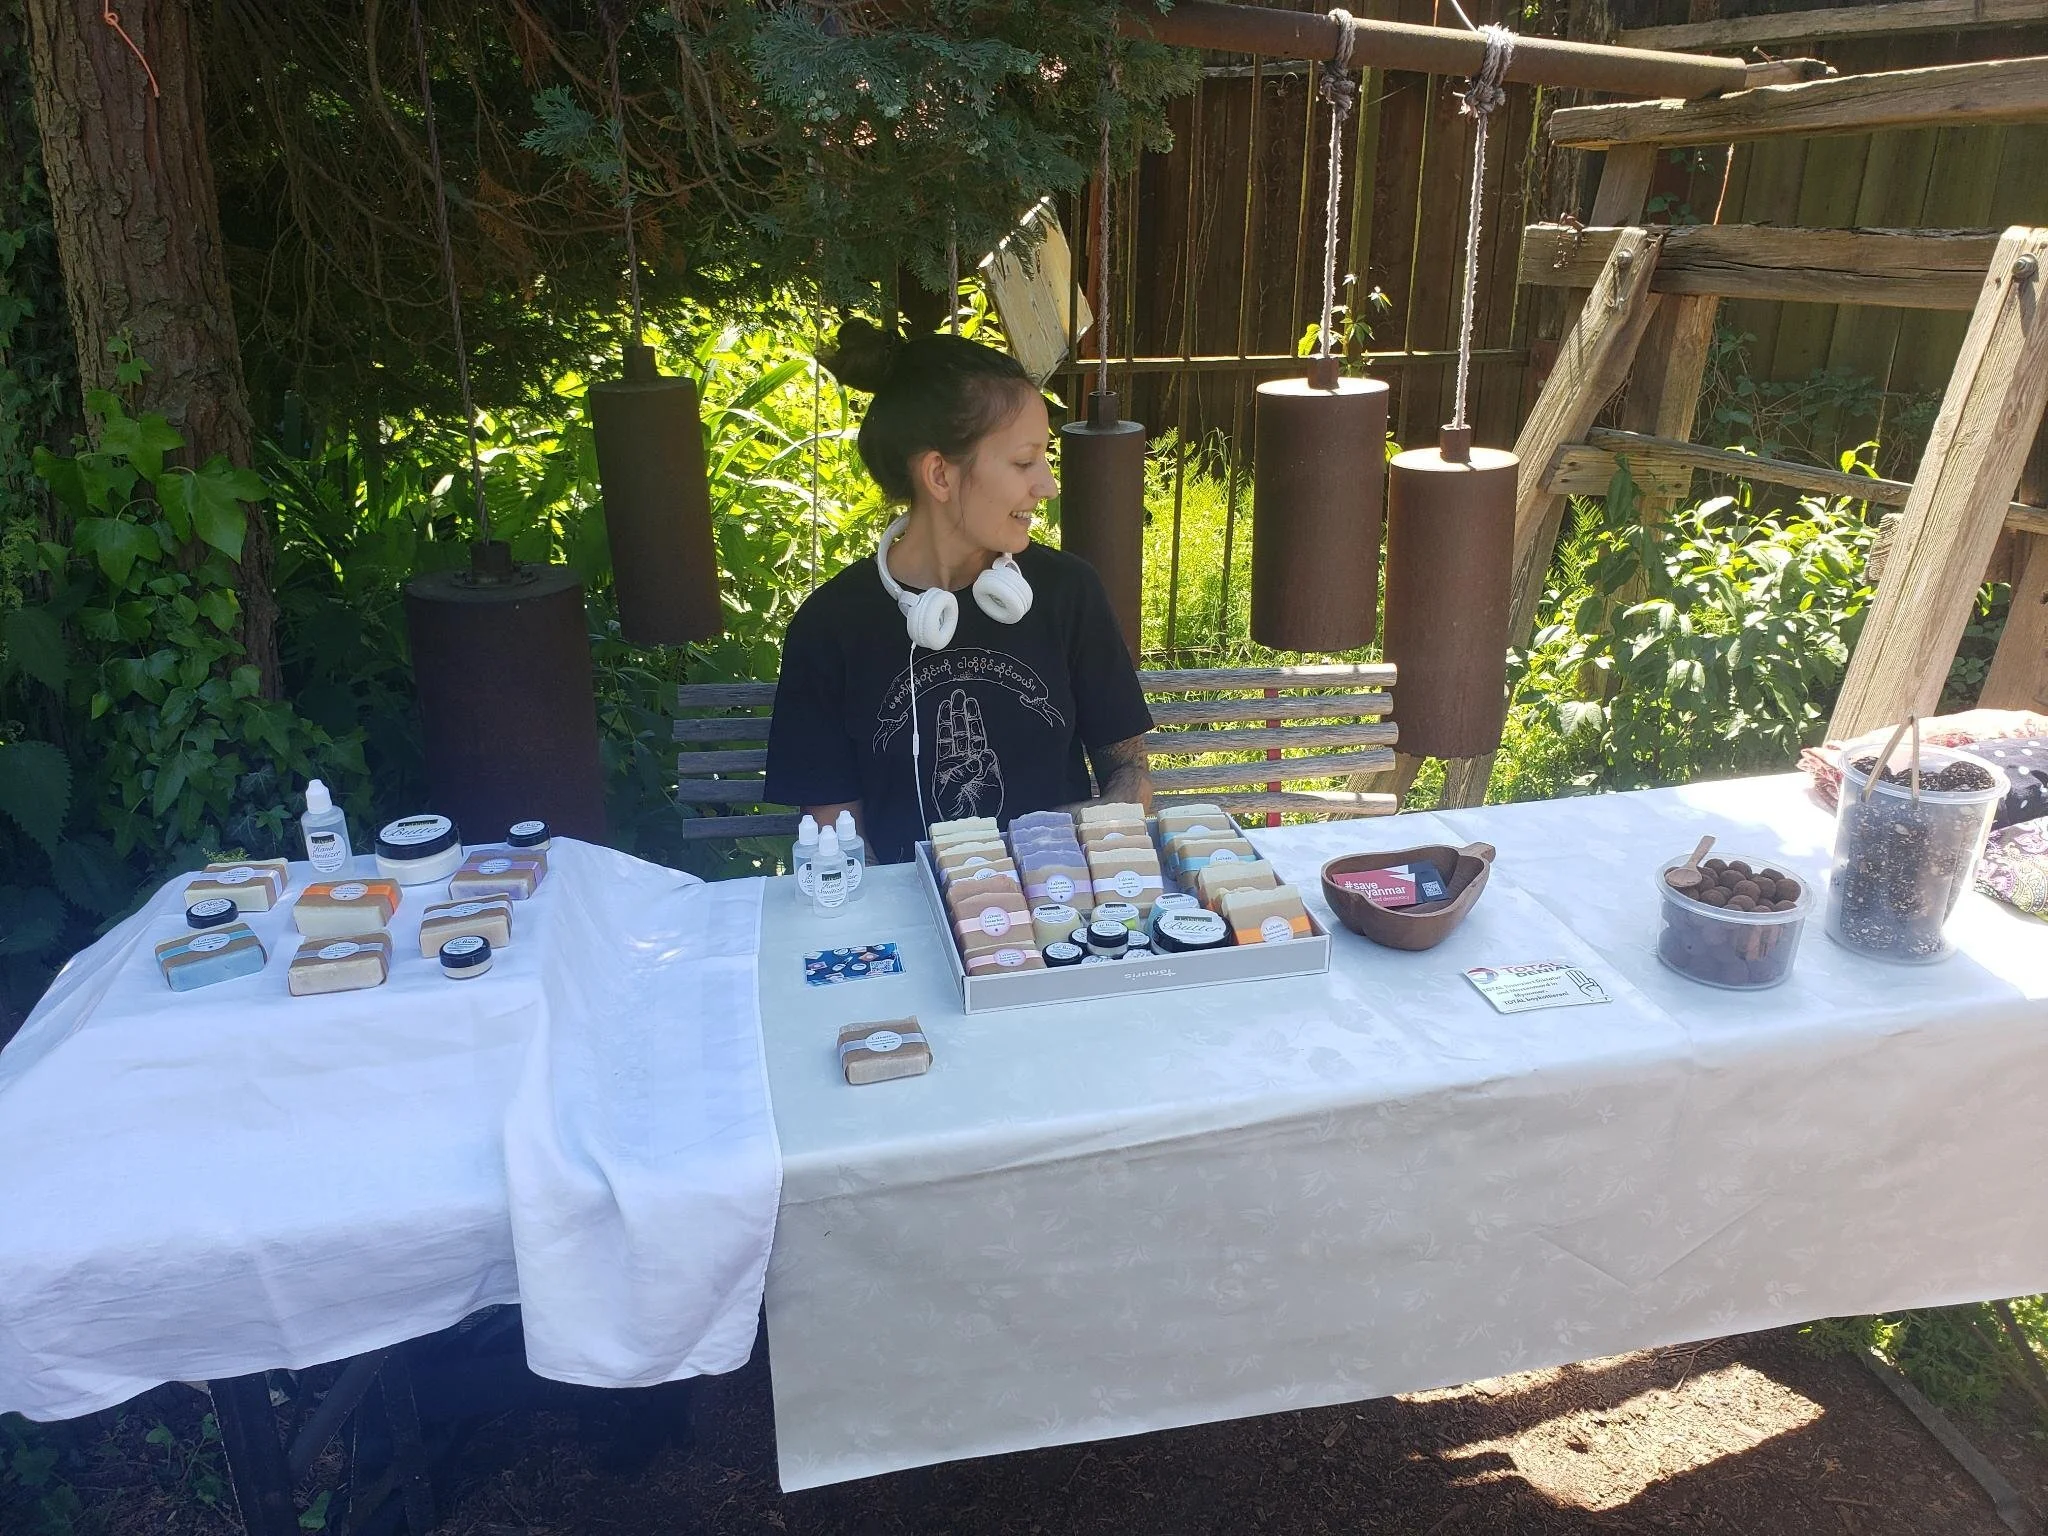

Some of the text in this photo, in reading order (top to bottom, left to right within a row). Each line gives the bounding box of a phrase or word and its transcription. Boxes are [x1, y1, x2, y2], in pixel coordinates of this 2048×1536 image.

[382, 827, 446, 837] Butter
[1344, 880, 1379, 891] #save
[1361, 886, 1406, 899] yanmar
[1162, 919, 1222, 933] Butter
[1124, 968, 1176, 980] Tamaris
[1502, 962, 1558, 974] TOTAL
[1515, 964, 1576, 978] DENIAL
